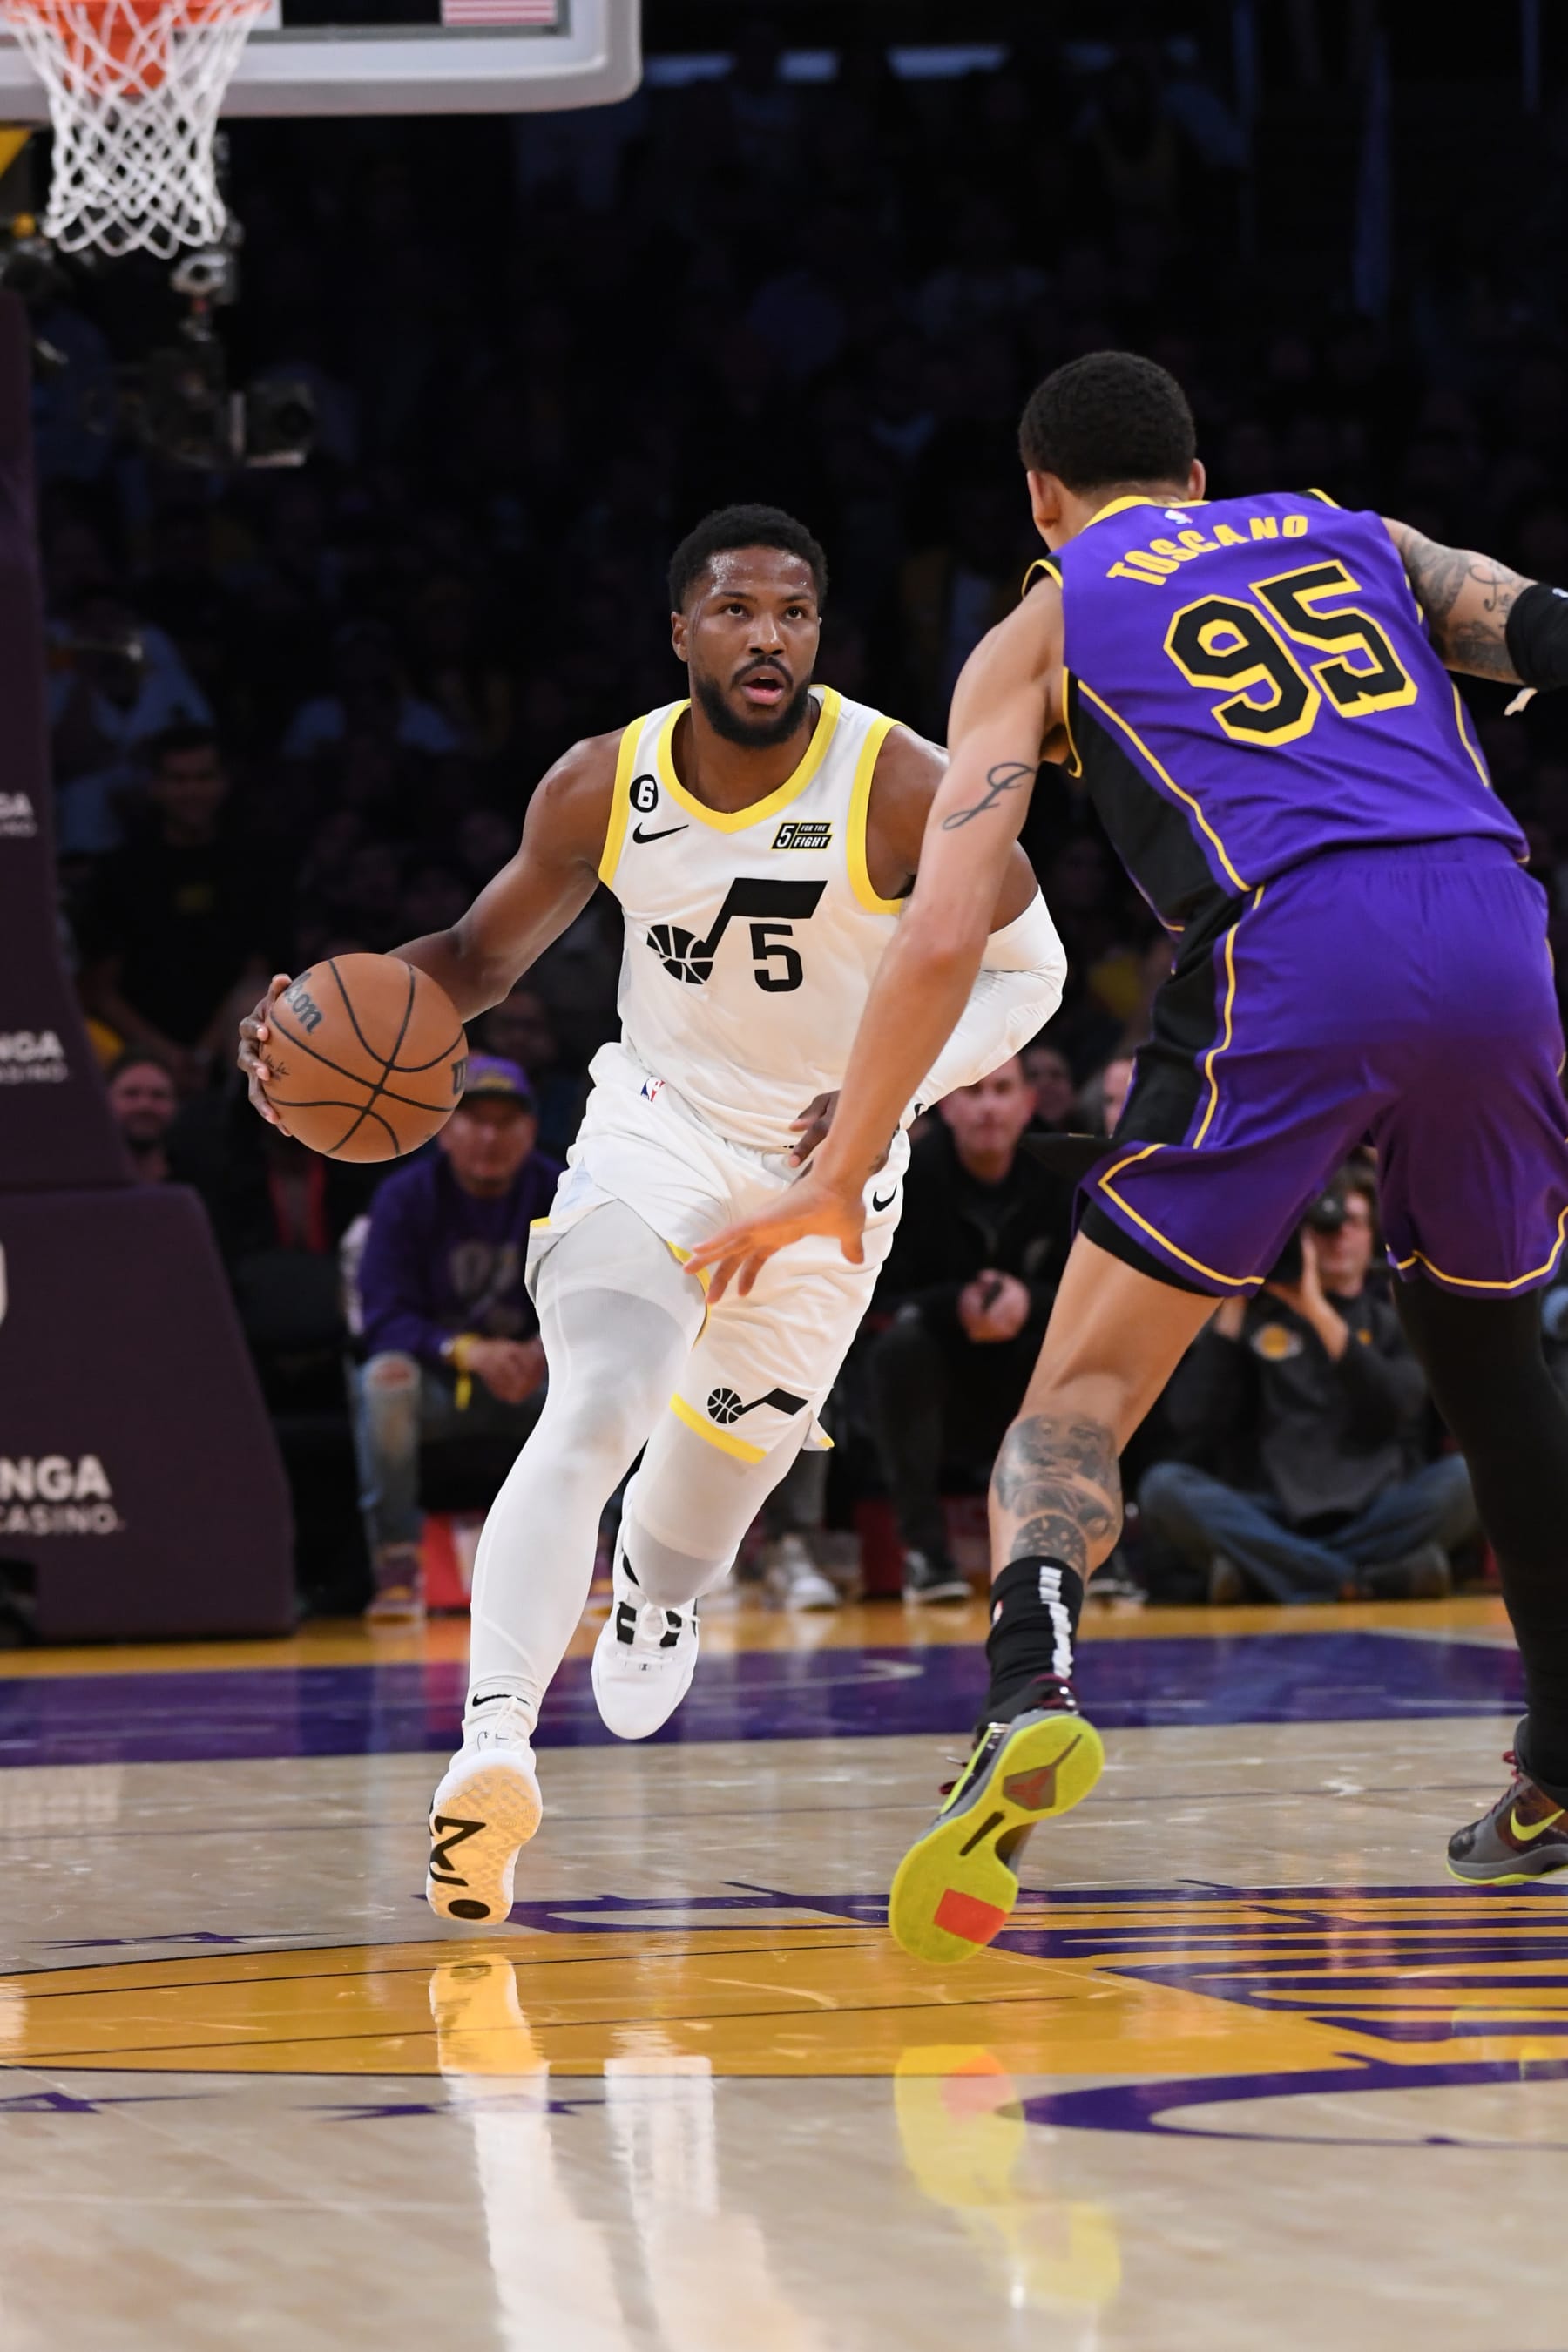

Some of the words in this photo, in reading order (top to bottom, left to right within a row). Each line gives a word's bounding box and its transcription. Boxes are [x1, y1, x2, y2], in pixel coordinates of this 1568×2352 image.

[1106, 515, 1308, 585] TOSCANO
[1163, 559, 1418, 747] 95
[637, 780, 655, 808] 6
[776, 825, 795, 848] 5
[793, 836, 828, 848] FIGHT
[749, 923, 803, 992] 5
[0, 1455, 112, 1501] NGA
[0, 1504, 118, 1536] ASINO
